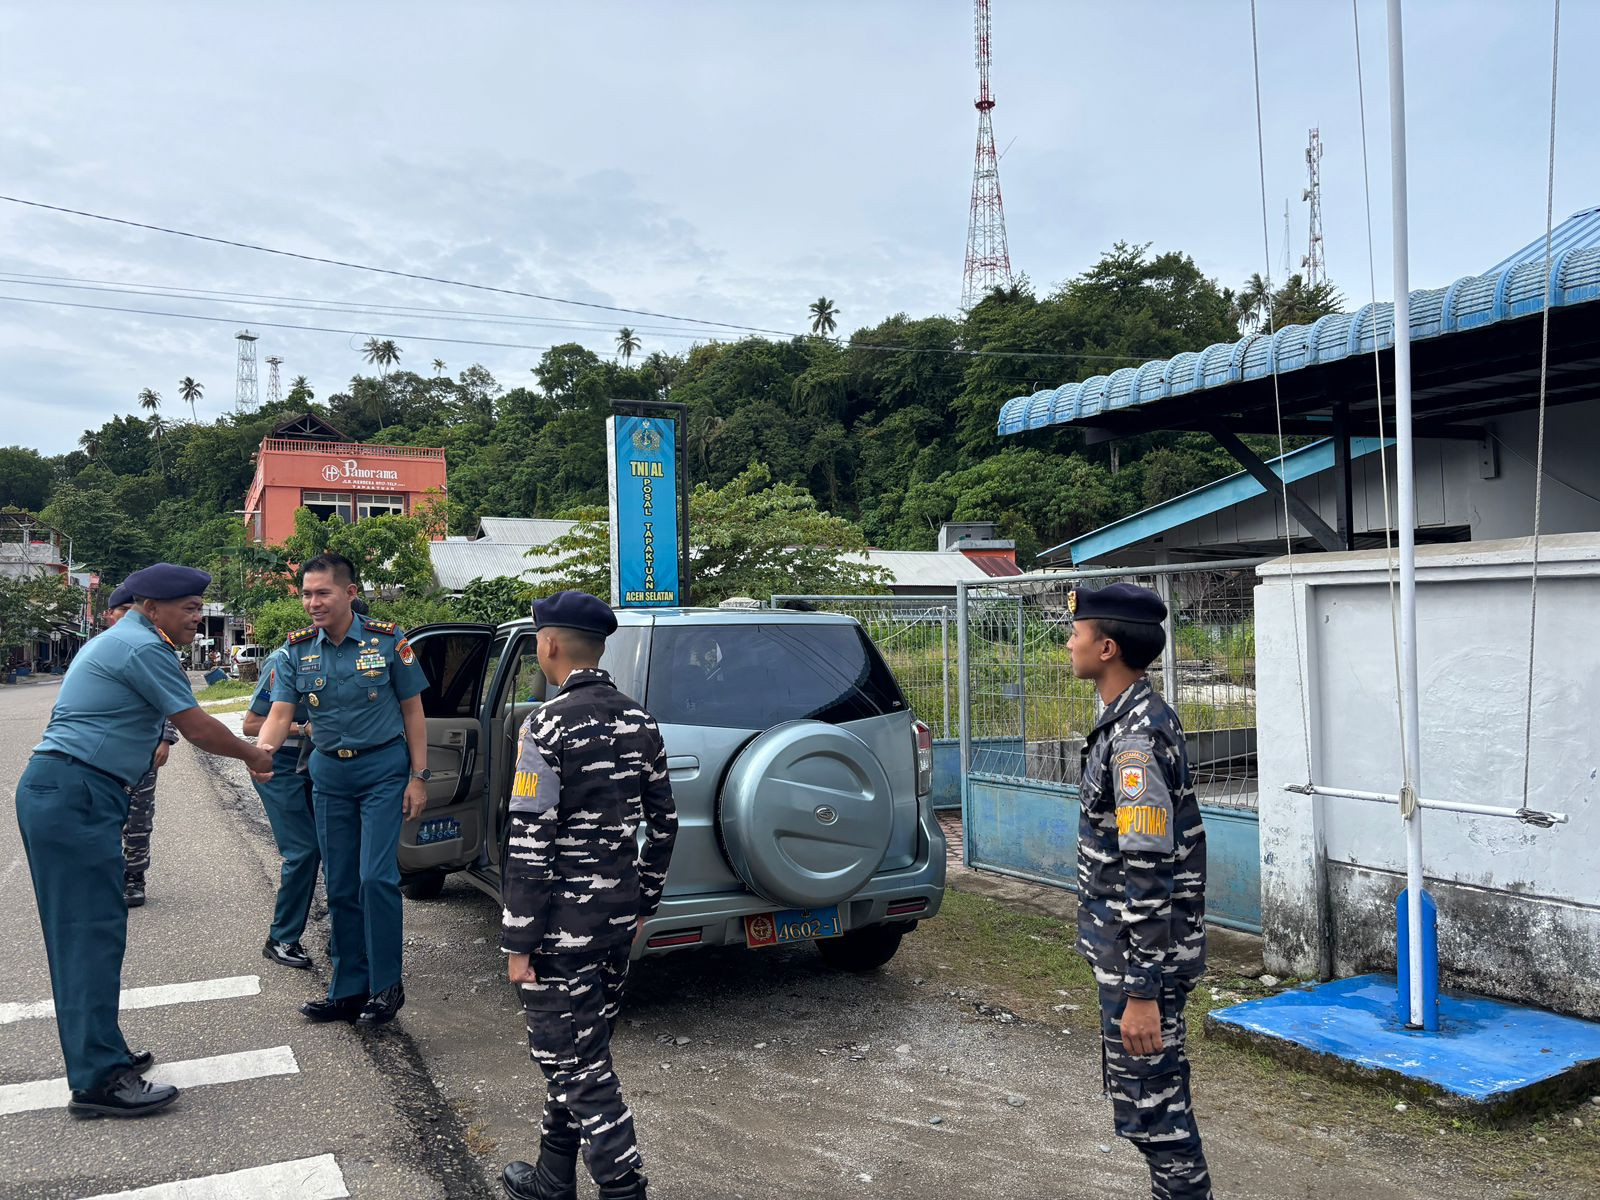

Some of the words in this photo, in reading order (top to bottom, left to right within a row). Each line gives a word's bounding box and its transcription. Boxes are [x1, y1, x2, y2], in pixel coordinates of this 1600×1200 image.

[337, 458, 398, 479] Panorama
[629, 461, 649, 477] TNI
[650, 462, 664, 477] AL
[642, 478, 653, 516] POSAL
[643, 522, 654, 589] TAPAKTUAN
[625, 591, 645, 602] ACEH
[645, 591, 674, 601] SELATAN
